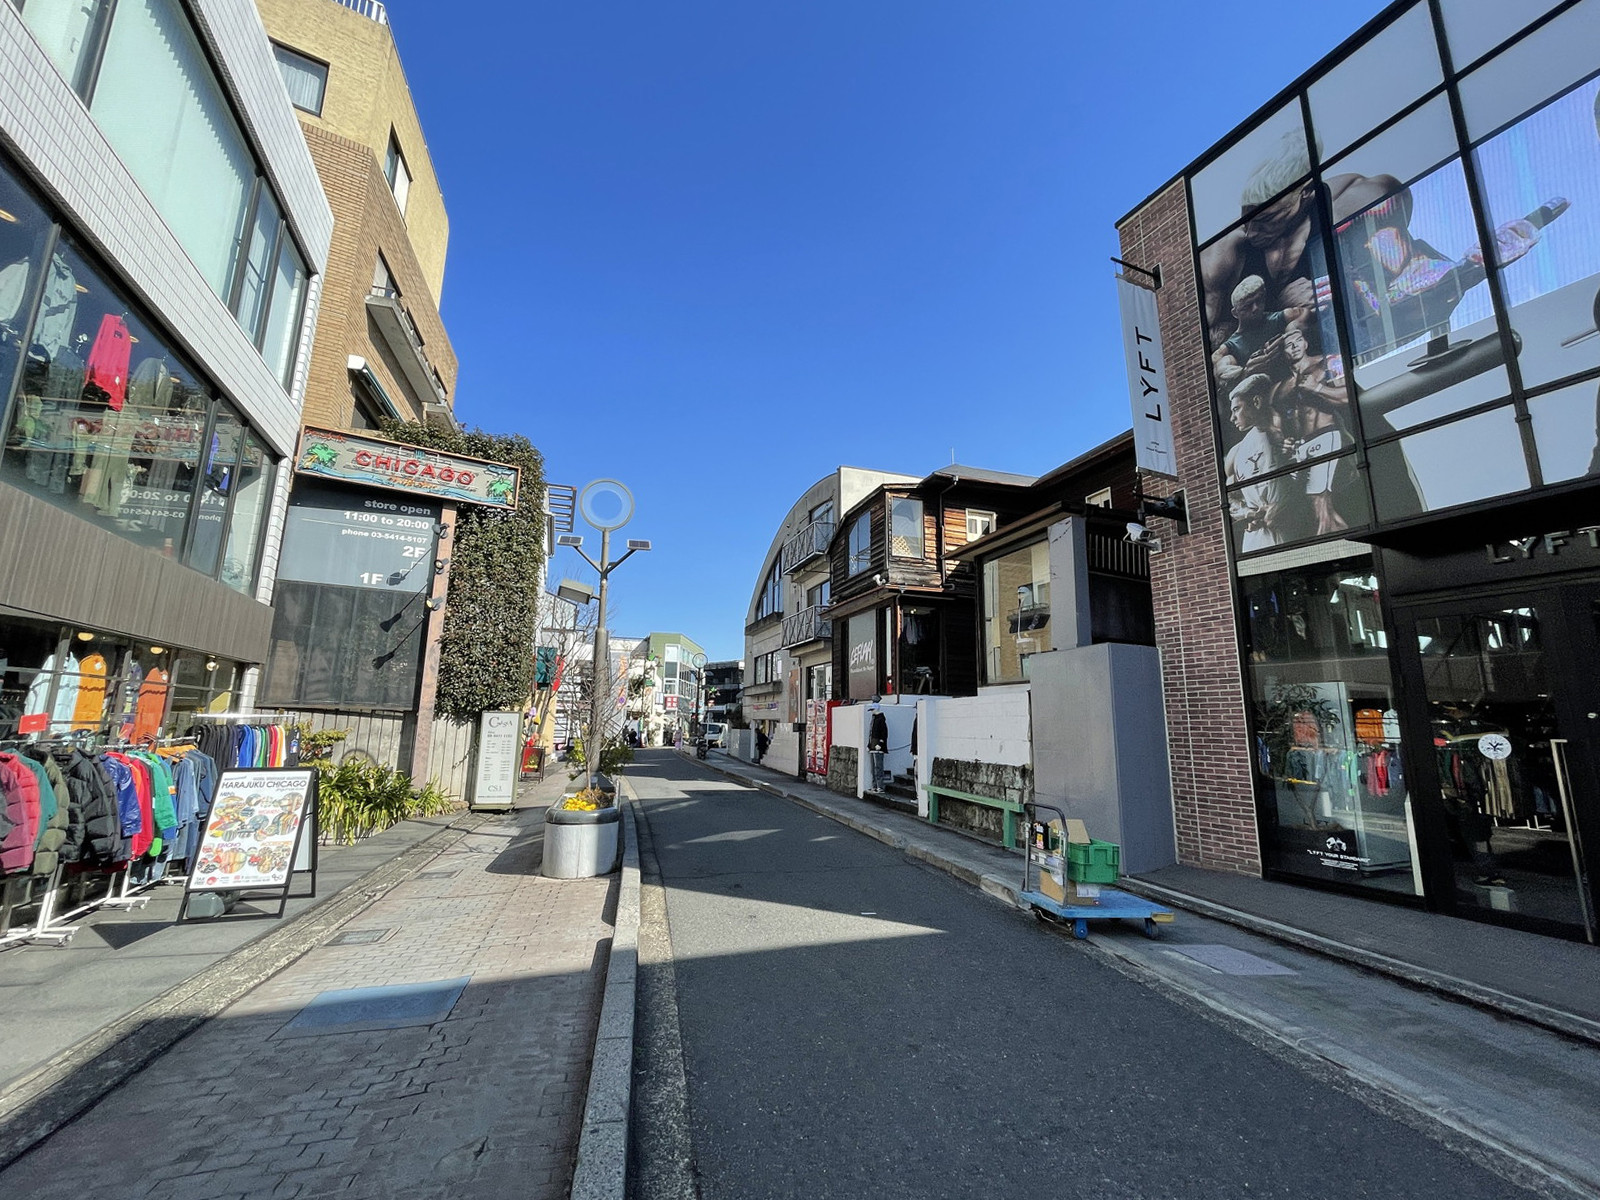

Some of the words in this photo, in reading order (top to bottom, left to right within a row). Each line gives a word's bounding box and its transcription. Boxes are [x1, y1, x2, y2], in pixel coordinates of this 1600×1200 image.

[355, 450, 475, 486] CHICAGO
[364, 500, 397, 511] store
[400, 505, 431, 515] open
[344, 511, 378, 523] 11:00
[381, 516, 393, 525] to
[396, 518, 429, 530] 20:00
[342, 529, 369, 537] phone
[371, 531, 428, 544] 03-5414-5107
[402, 545, 426, 558] 2F
[360, 572, 384, 585] 1F
[266, 780, 307, 788] CHICAGO
